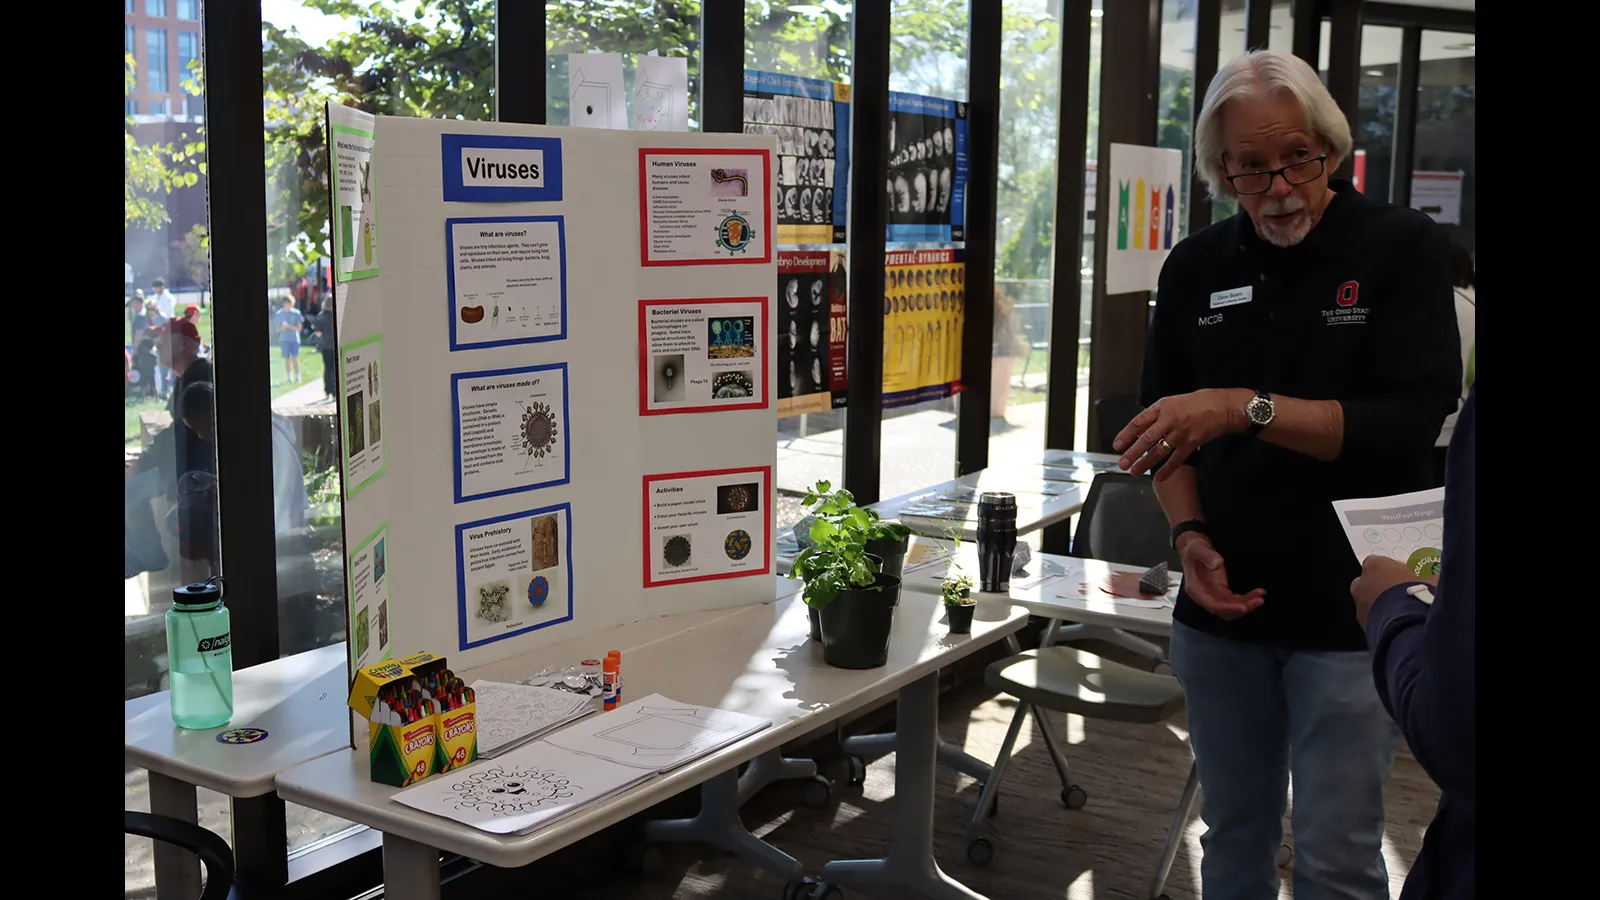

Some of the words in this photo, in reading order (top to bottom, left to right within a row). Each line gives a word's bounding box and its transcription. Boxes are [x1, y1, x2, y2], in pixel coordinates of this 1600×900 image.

[466, 157, 539, 179] Viruses
[793, 256, 826, 268] Development
[1198, 313, 1223, 326] MCDB
[830, 317, 846, 342] BAT
[1381, 512, 1413, 521] WestFest
[469, 532, 483, 540] Virus
[484, 527, 512, 537] Prehistory
[1414, 556, 1441, 576] OLECULA
[369, 663, 397, 674] Crayola
[444, 721, 474, 740] CRAYONS
[405, 733, 434, 754] CRAYONS
[456, 750, 465, 759] 48
[417, 762, 425, 772] 48
